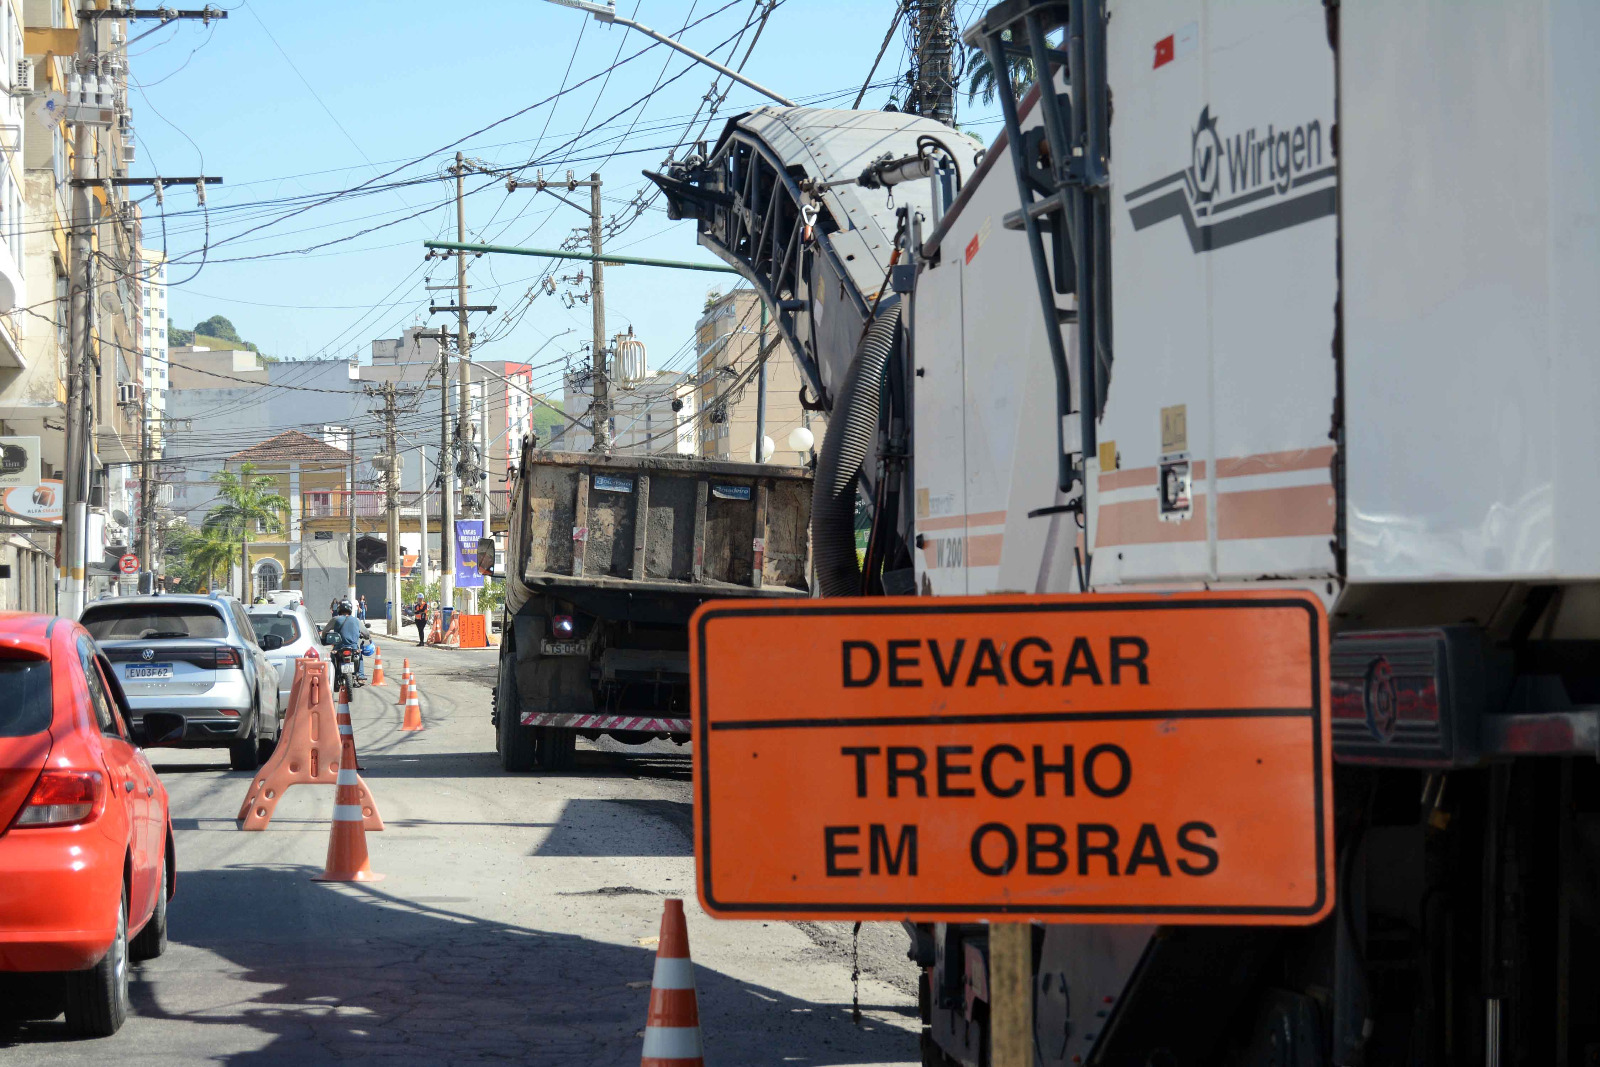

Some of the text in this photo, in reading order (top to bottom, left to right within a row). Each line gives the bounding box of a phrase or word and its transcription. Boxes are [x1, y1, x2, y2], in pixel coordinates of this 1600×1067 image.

[1226, 118, 1322, 195] Wirtgen
[946, 537, 962, 568] 200
[841, 636, 1151, 689] DEVAGAR
[841, 743, 1132, 799] TRECHO
[823, 821, 1220, 877] EM OBRAS
